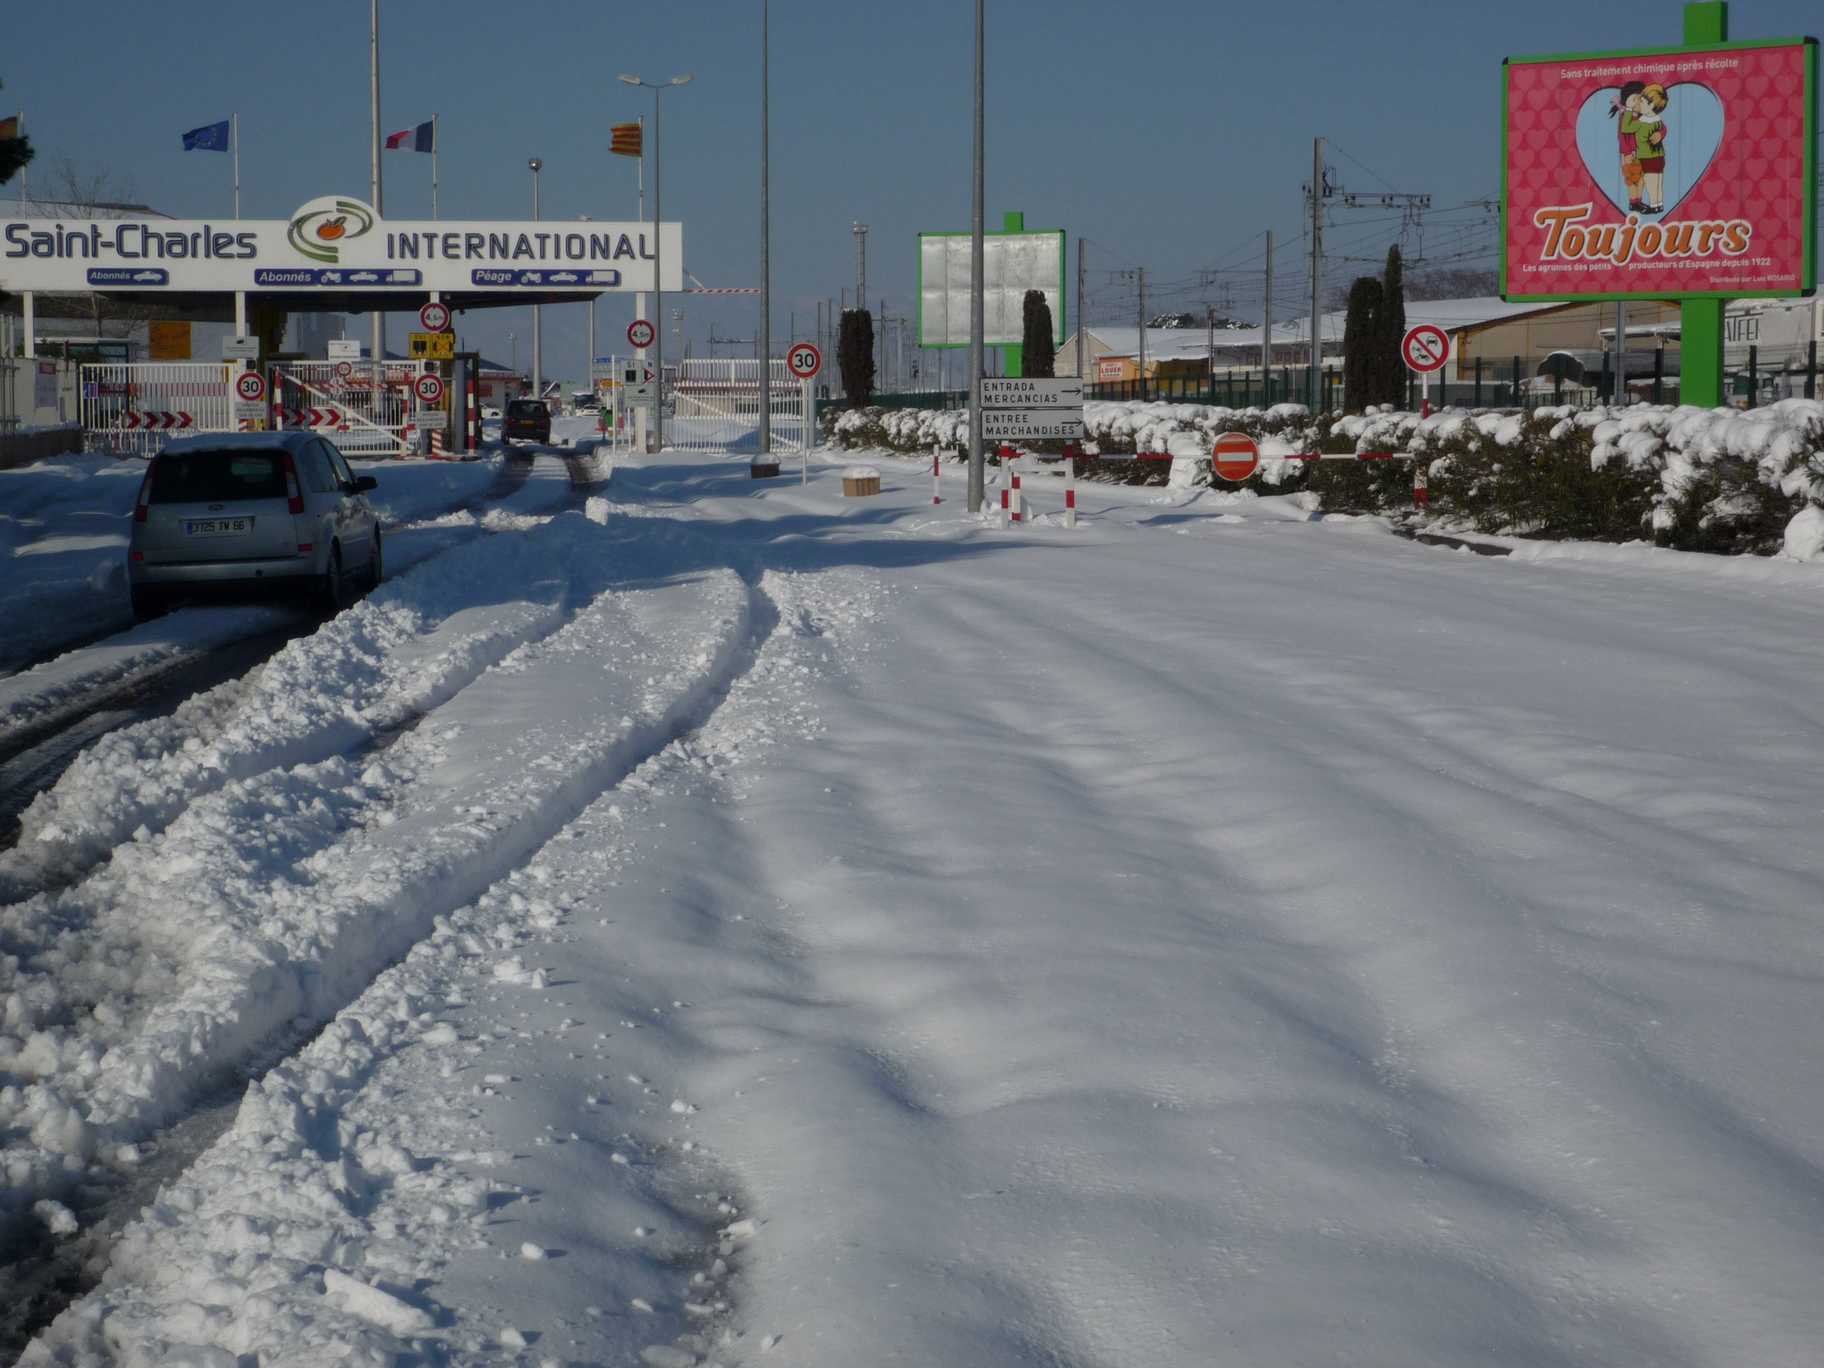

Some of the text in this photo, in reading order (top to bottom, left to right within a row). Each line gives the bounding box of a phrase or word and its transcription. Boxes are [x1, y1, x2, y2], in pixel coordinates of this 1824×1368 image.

[1561, 58, 1739, 79] Sans traitement chimique après récolte
[1534, 202, 1753, 266] Toujours
[5, 223, 257, 258] Saint-Charles
[387, 233, 656, 260] INTERNATIONAL
[1523, 264, 1536, 272] Les
[1574, 263, 1588, 272] des
[1629, 261, 1677, 272] producteurs
[1679, 259, 1720, 271] d'Espagne
[1721, 258, 1750, 269] depuis
[1752, 257, 1771, 267] 1922
[91, 271, 131, 280] Abonnés
[259, 271, 312, 282] Abonnés
[476, 271, 512, 283] Péage
[795, 353, 815, 368] 30
[242, 381, 259, 393] 30
[421, 382, 438, 394] 30
[984, 382, 1035, 391] ENTRADA
[984, 394, 1058, 403] MERCANCIAS
[985, 414, 1028, 423] ENTREE
[985, 426, 1074, 435] MARCHANDISES
